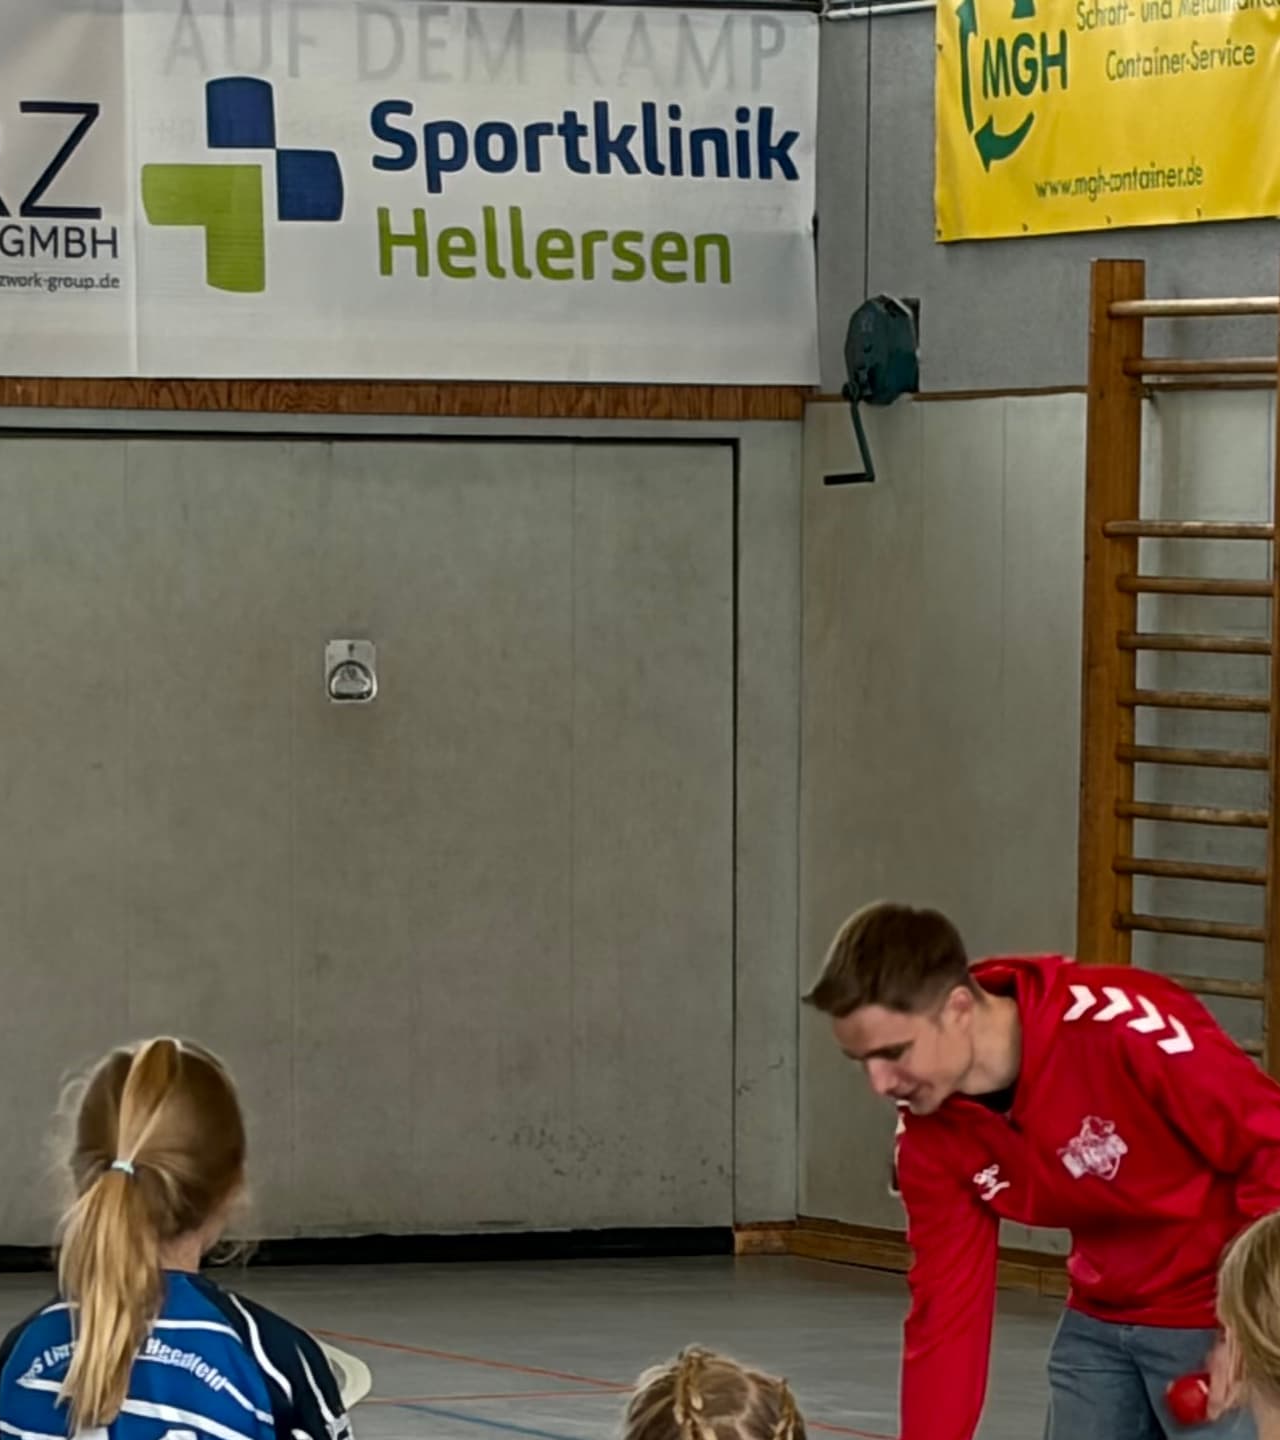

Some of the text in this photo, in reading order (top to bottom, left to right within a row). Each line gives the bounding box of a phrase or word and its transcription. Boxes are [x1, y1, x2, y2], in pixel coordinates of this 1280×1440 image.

[163, 0, 785, 92] AUF DEM KAMP
[982, 29, 1068, 99] MGH
[1106, 38, 1256, 82] Container-Service
[369, 99, 801, 194] Sportklinik
[1033, 155, 1204, 202] www.mgh-container.de
[376, 205, 732, 284] Hellersen
